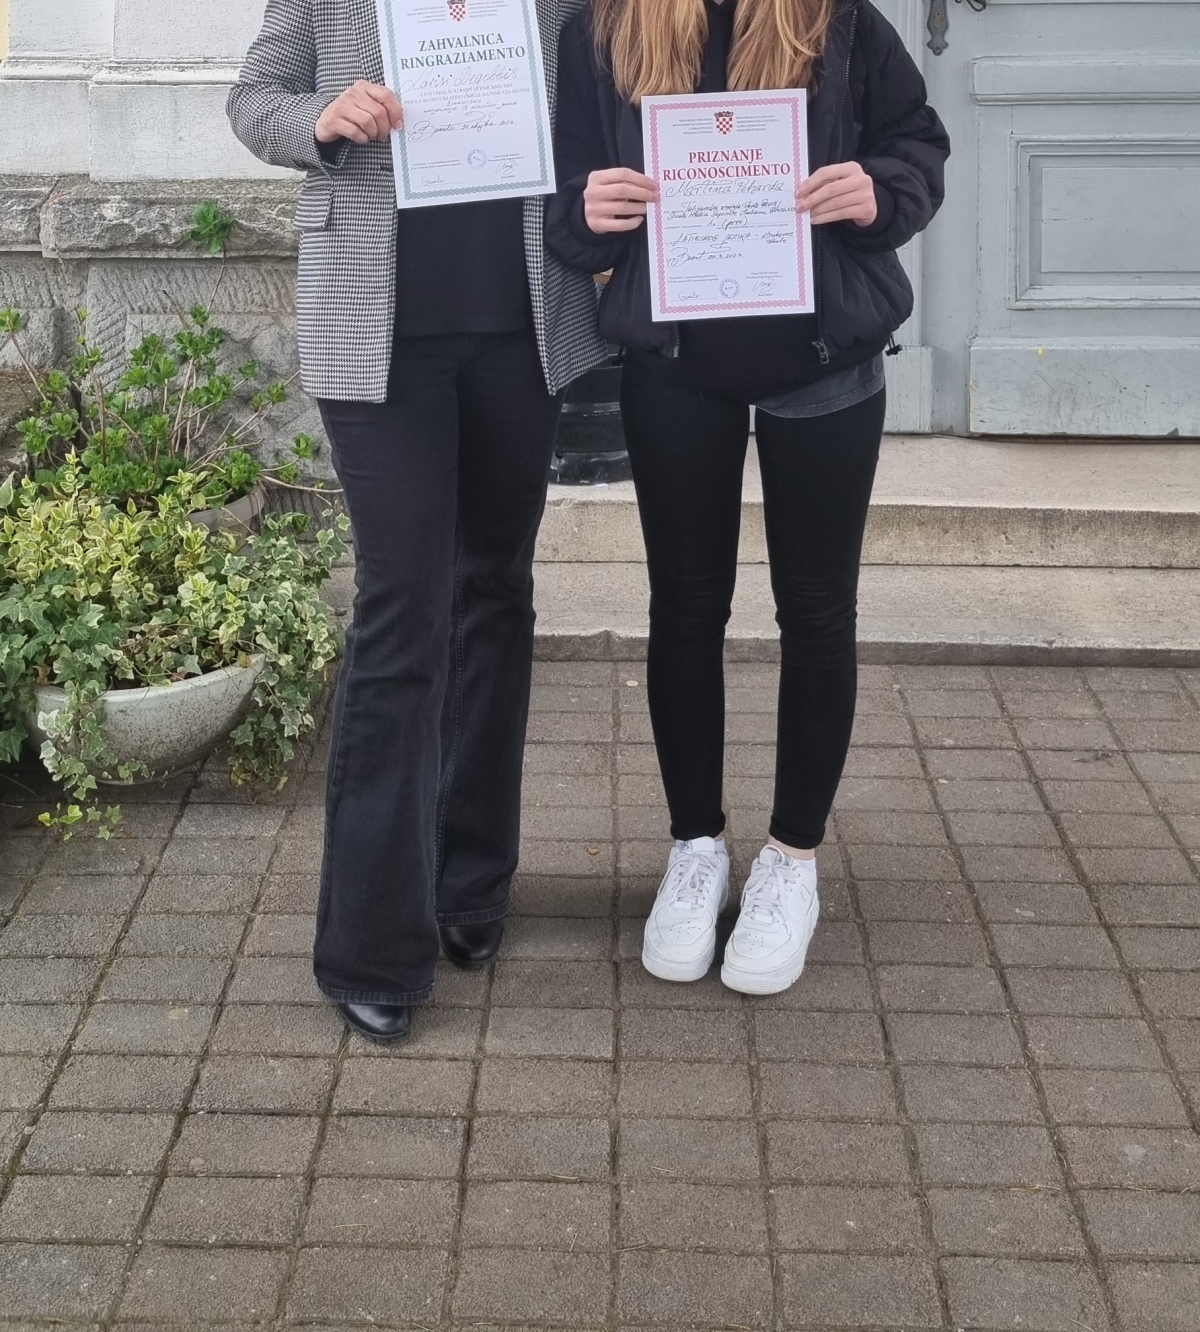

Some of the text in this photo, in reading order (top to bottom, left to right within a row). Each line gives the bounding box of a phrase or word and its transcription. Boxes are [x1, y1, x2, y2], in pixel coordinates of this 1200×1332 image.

[418, 32, 505, 52] ZAHVALNICA
[400, 45, 525, 70] RINGRAZIAMENTO
[688, 148, 764, 164] PRIZNANJE
[663, 162, 791, 181] RICONOSCIMENTO
[666, 179, 732, 198] Martina
